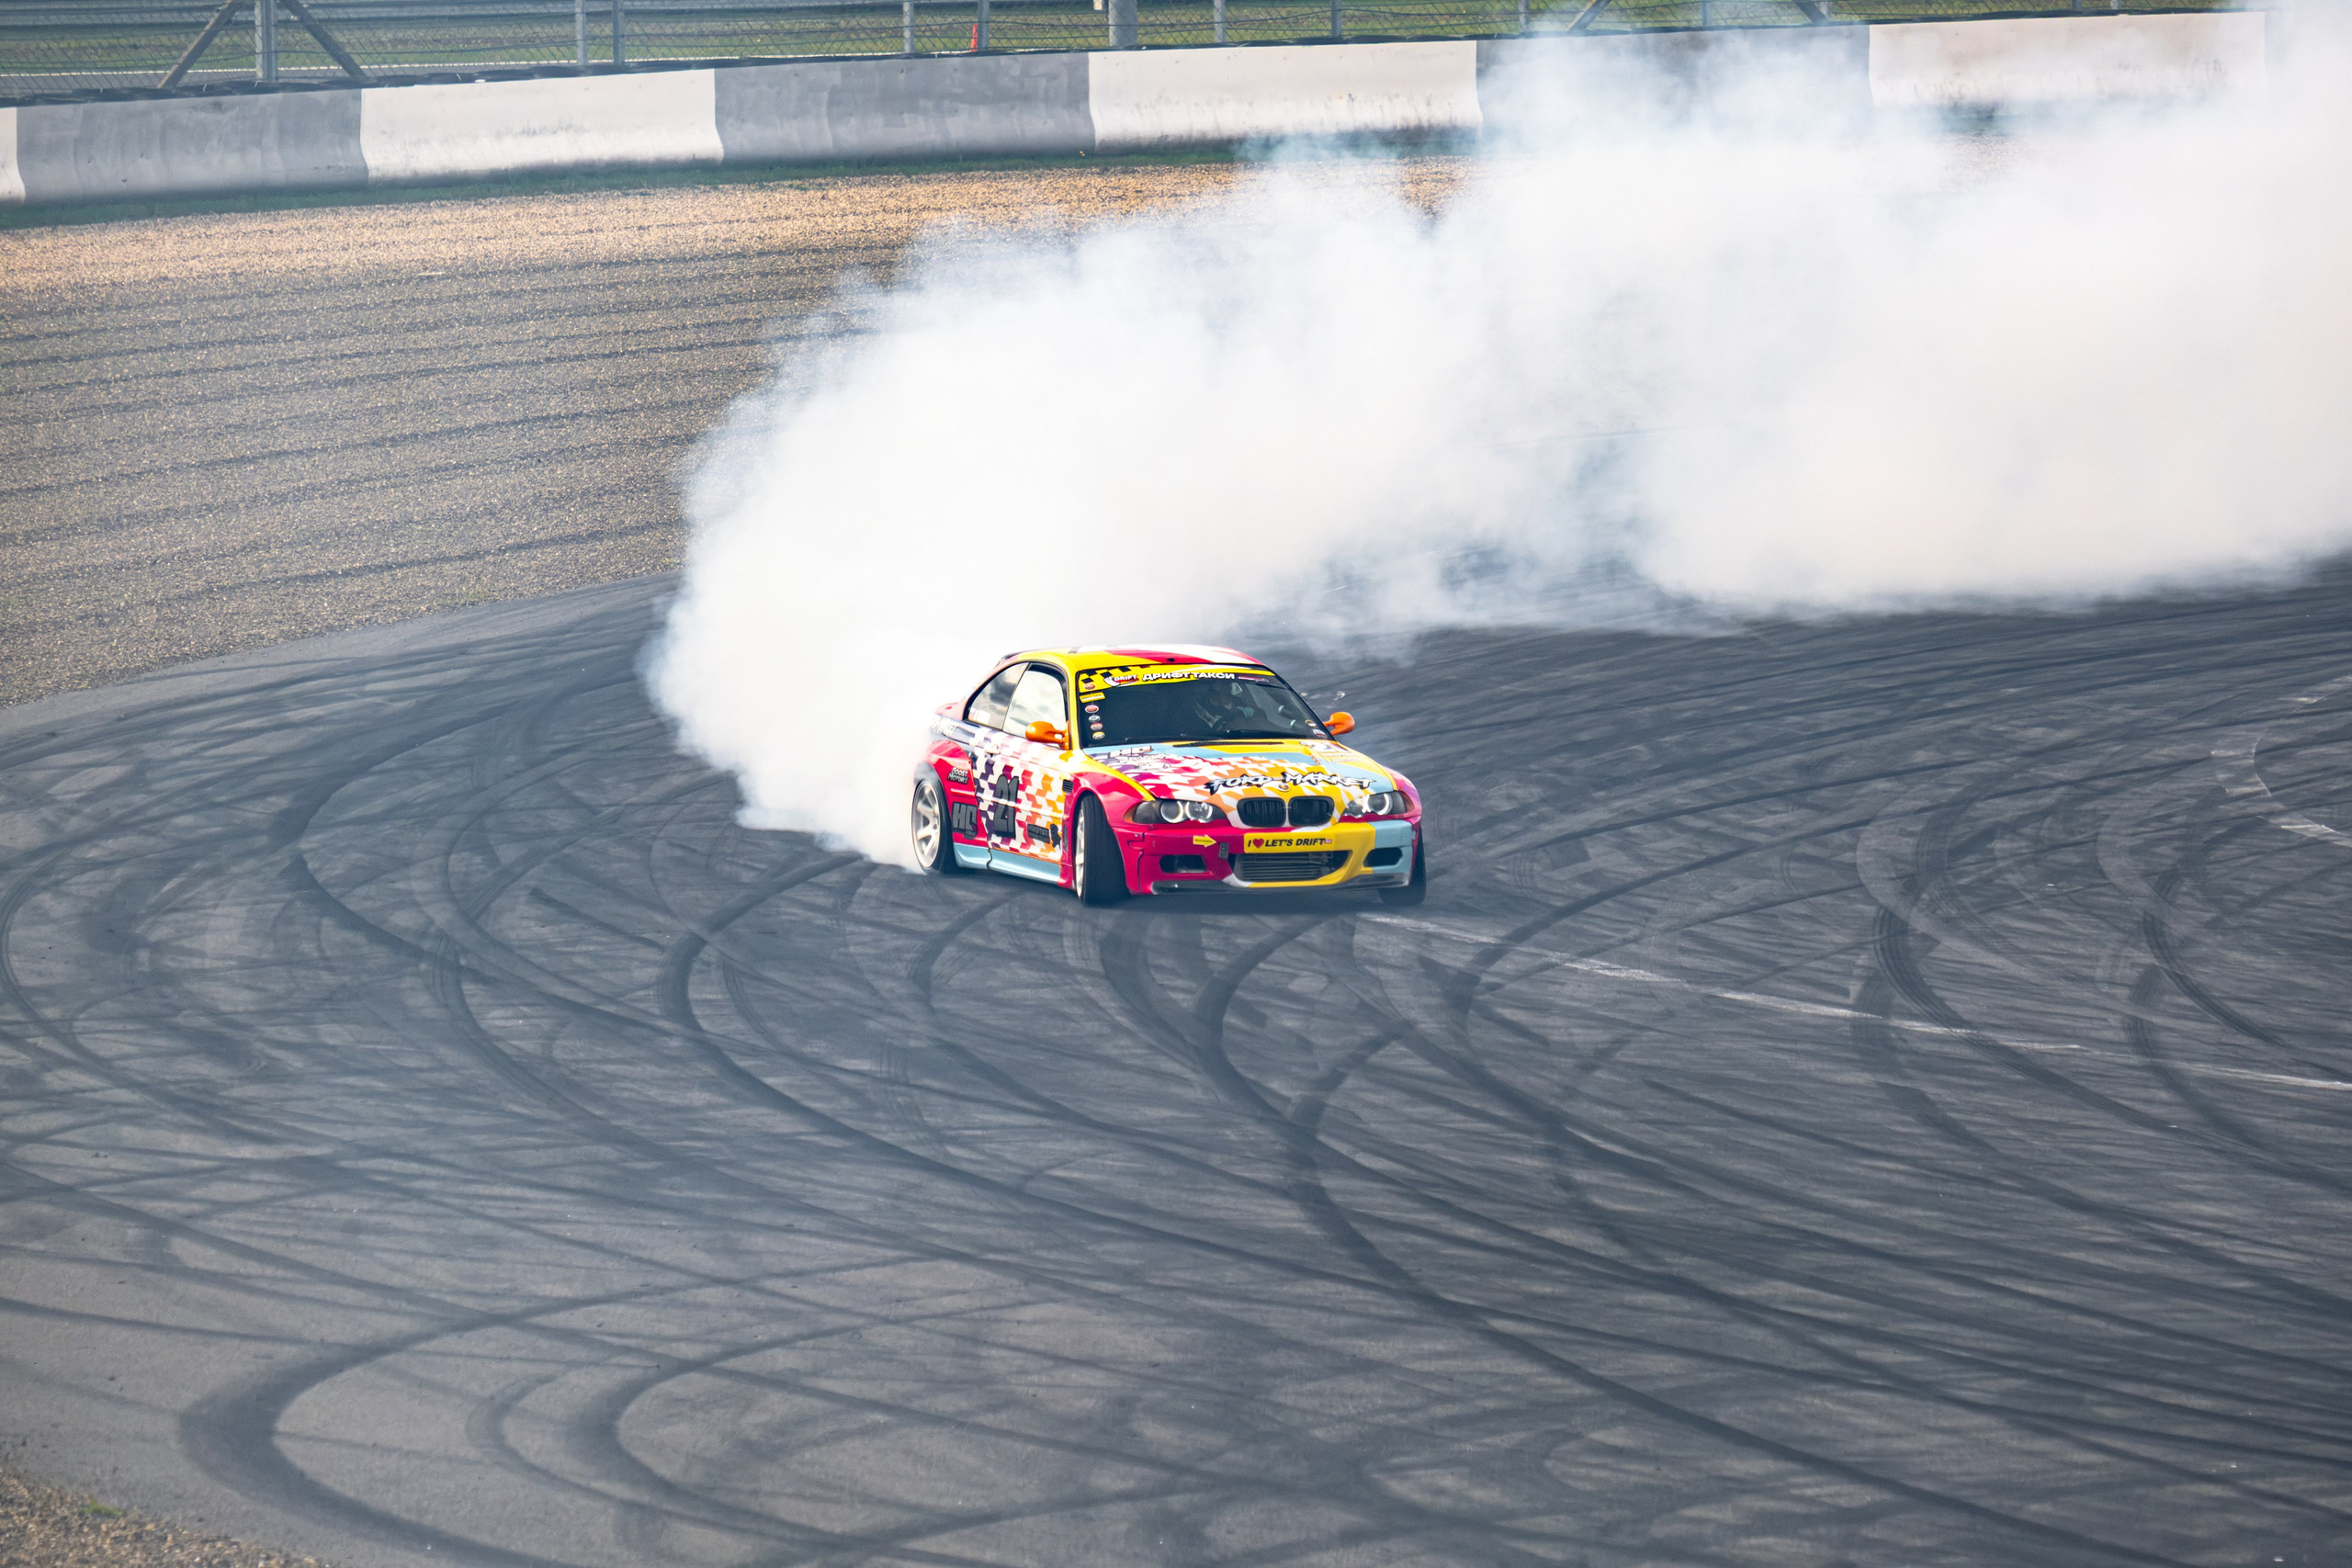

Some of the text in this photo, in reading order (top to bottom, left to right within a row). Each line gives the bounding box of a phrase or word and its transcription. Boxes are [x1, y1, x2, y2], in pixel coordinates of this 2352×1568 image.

[1142, 672, 1190, 682] ДРИФТ
[993, 774, 1020, 840] 21
[1247, 838, 1326, 848] I LET'S DRIFT
